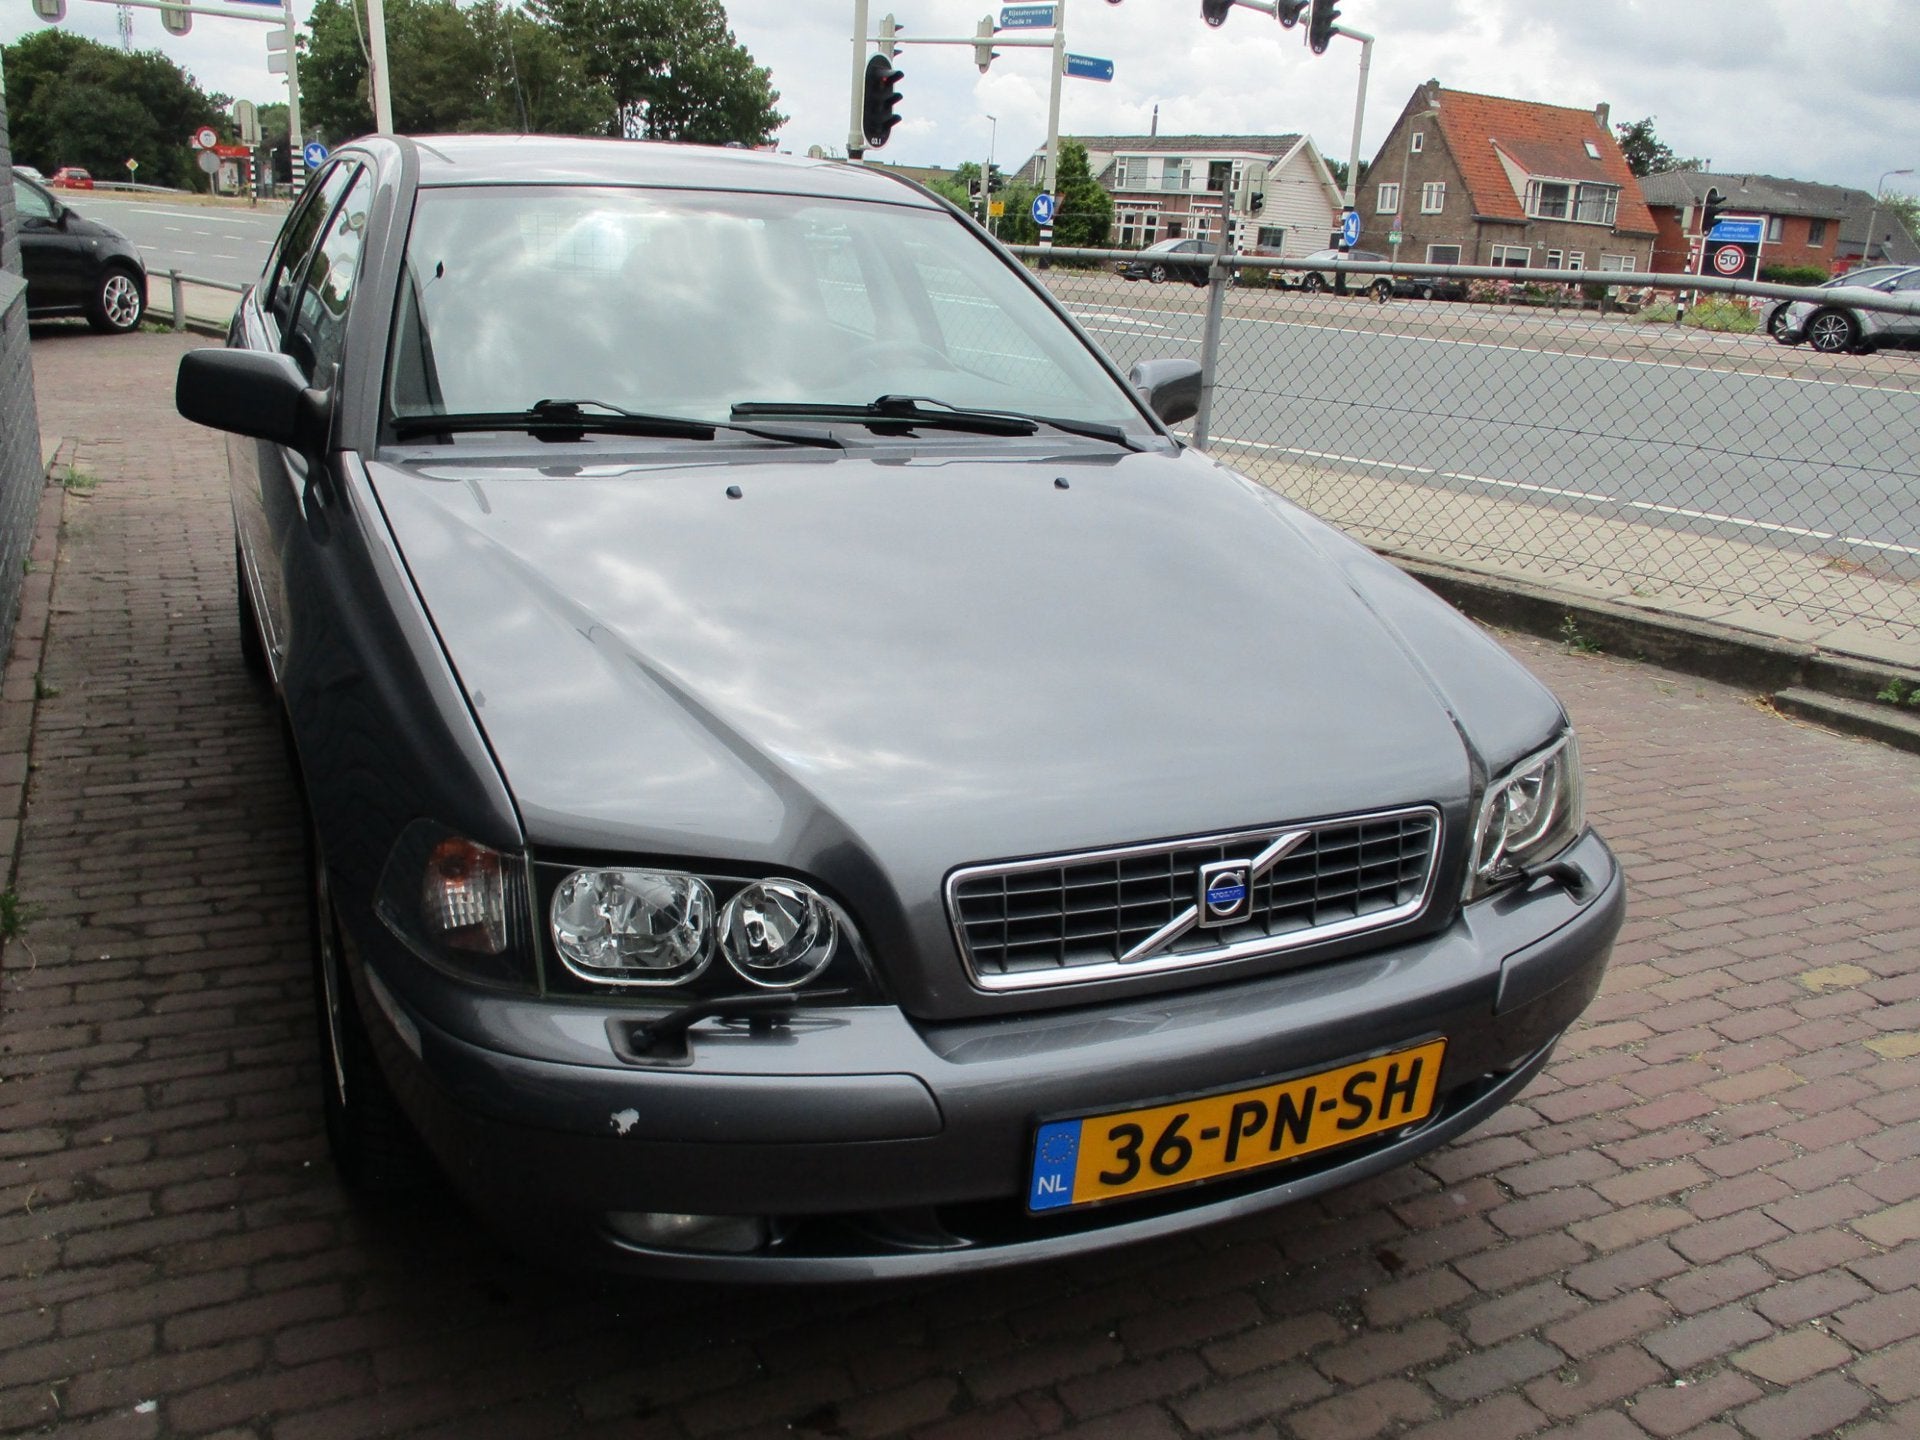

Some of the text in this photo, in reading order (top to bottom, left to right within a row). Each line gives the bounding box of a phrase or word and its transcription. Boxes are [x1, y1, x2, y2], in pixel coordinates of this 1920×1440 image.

[1720, 254, 1739, 266] 50
[1099, 1057, 1423, 1186] 36-PN-SH
[1037, 1176, 1068, 1196] NL
